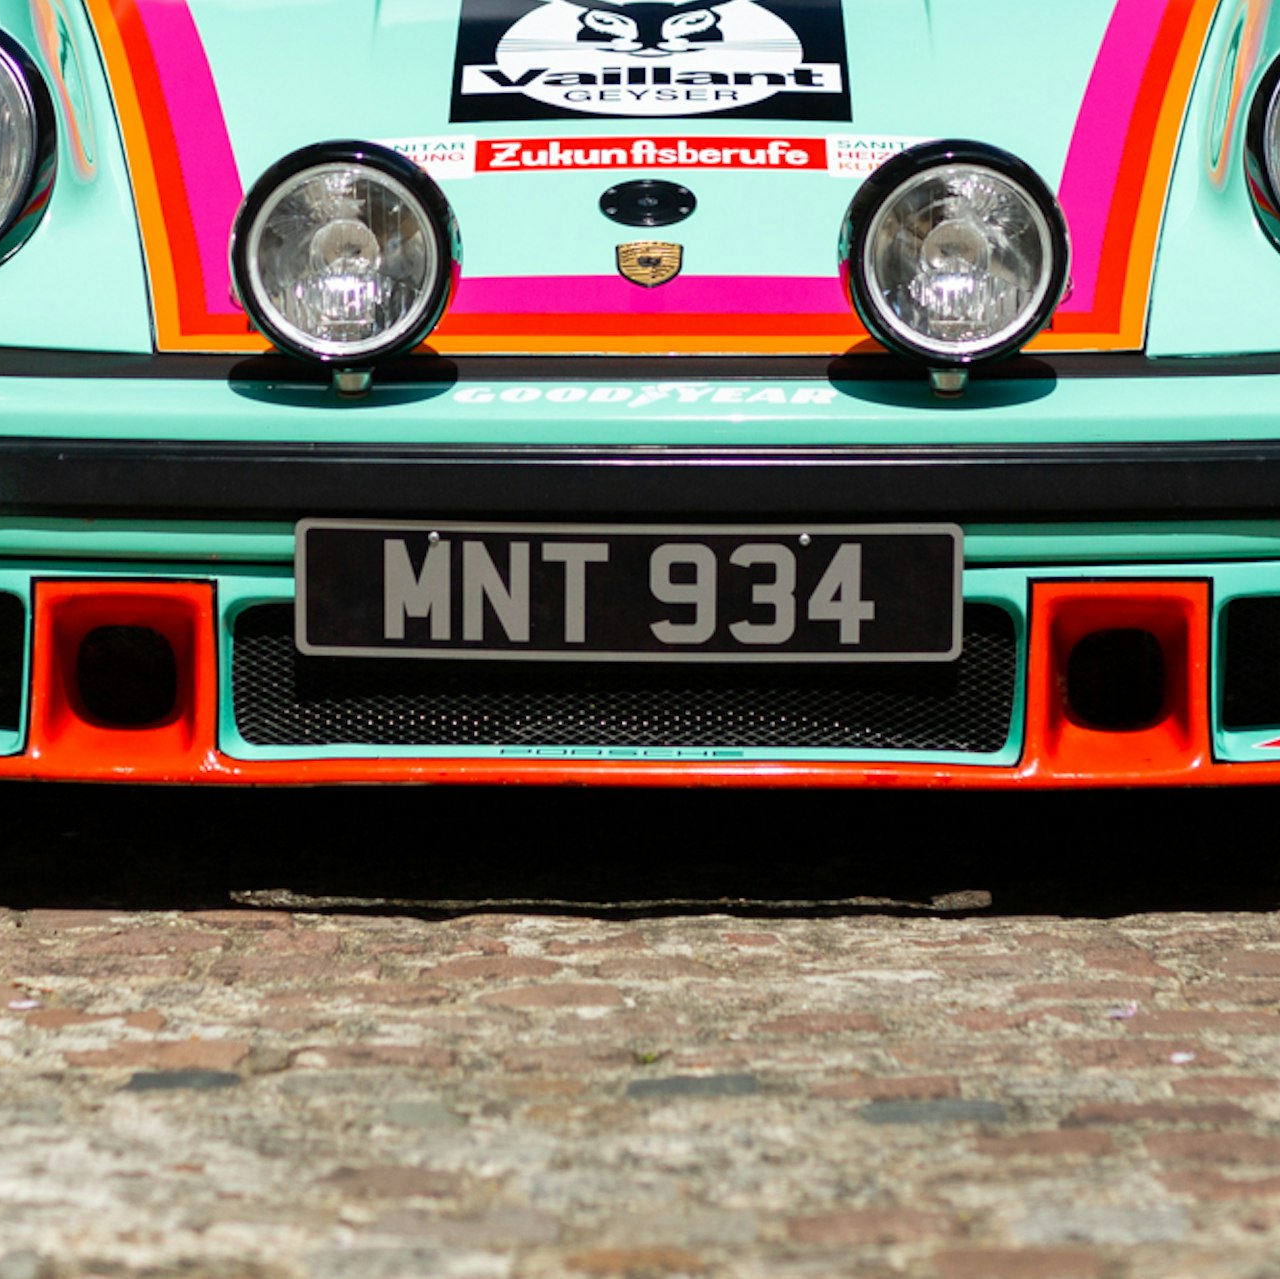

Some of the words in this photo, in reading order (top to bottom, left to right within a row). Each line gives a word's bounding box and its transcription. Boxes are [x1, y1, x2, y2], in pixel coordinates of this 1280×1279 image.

[478, 66, 825, 88] Vaillant
[563, 89, 739, 102] GEYSER
[837, 139, 907, 150] SANIT
[837, 150, 896, 160] HEIZ
[383, 538, 609, 644] MNT
[648, 542, 876, 646] 934
